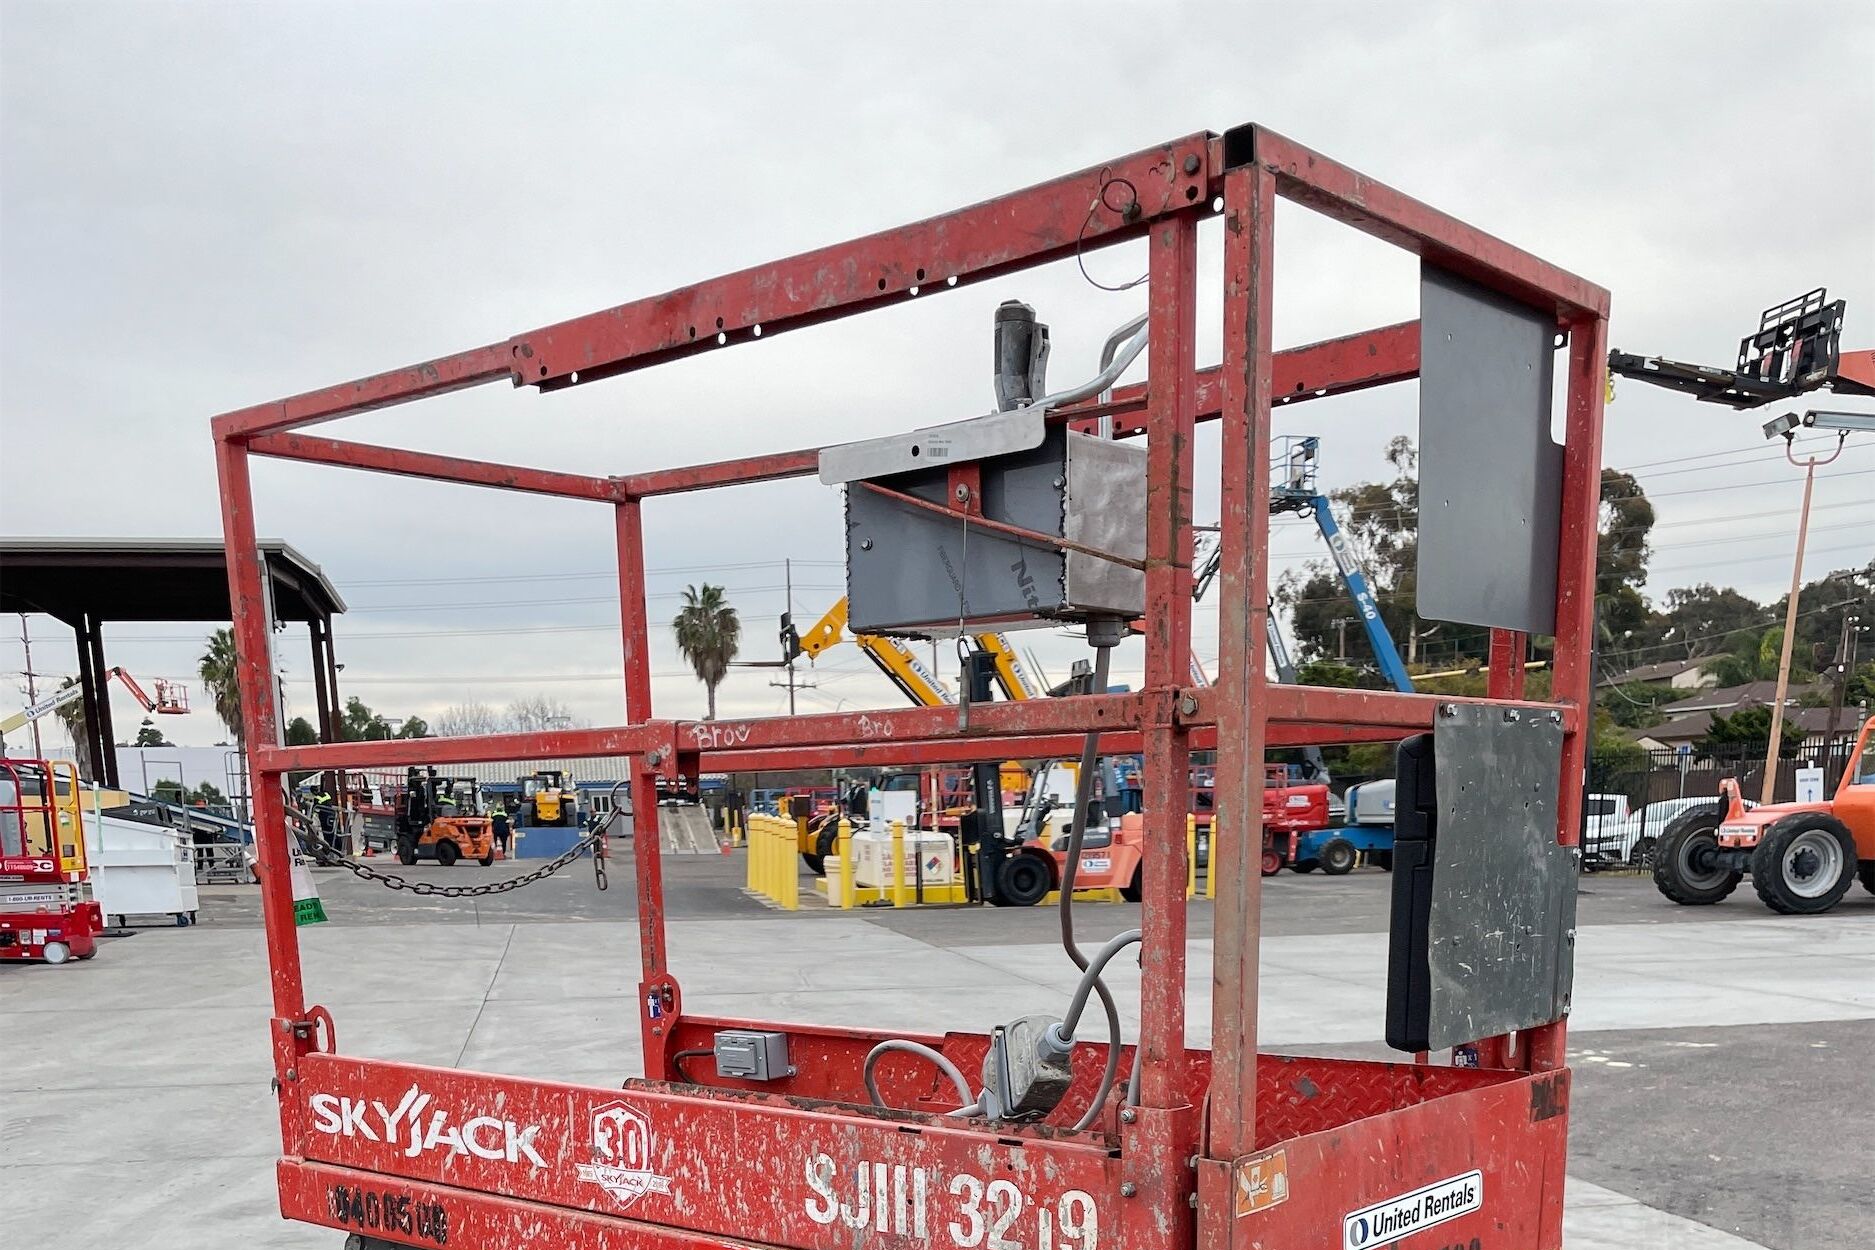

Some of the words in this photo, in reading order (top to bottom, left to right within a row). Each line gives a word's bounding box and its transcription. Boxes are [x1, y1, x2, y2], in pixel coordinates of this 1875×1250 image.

[1357, 592, 1376, 619] S-40
[35, 700, 55, 713] United
[56, 690, 78, 703] Rentals
[920, 671, 943, 694] United
[310, 1083, 548, 1168] SKYJACK
[599, 1116, 643, 1169] 30
[601, 1173, 644, 1187] SKYJACK
[805, 1153, 927, 1240] SJIII
[1373, 1199, 1421, 1237] United
[1424, 1183, 1474, 1219] Rentals
